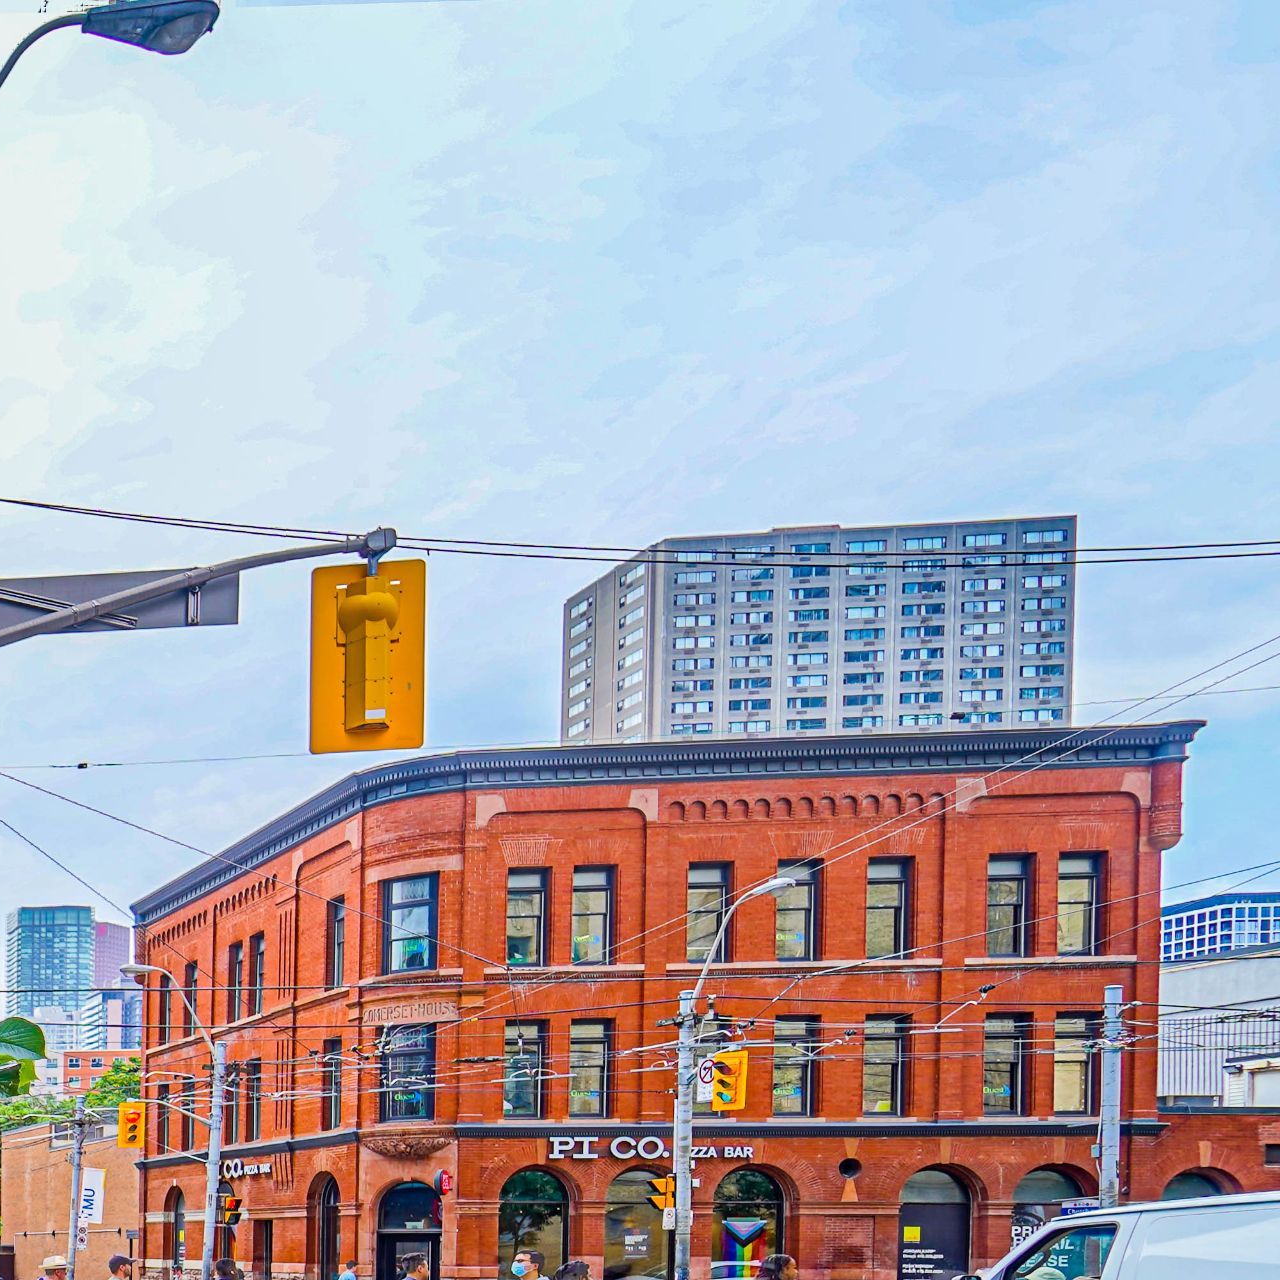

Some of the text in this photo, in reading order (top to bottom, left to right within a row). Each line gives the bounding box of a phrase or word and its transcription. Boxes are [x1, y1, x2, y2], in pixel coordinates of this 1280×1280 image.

[549, 1136, 754, 1160] PI CO. ZZA BAR
[223, 1158, 243, 1179] CO.
